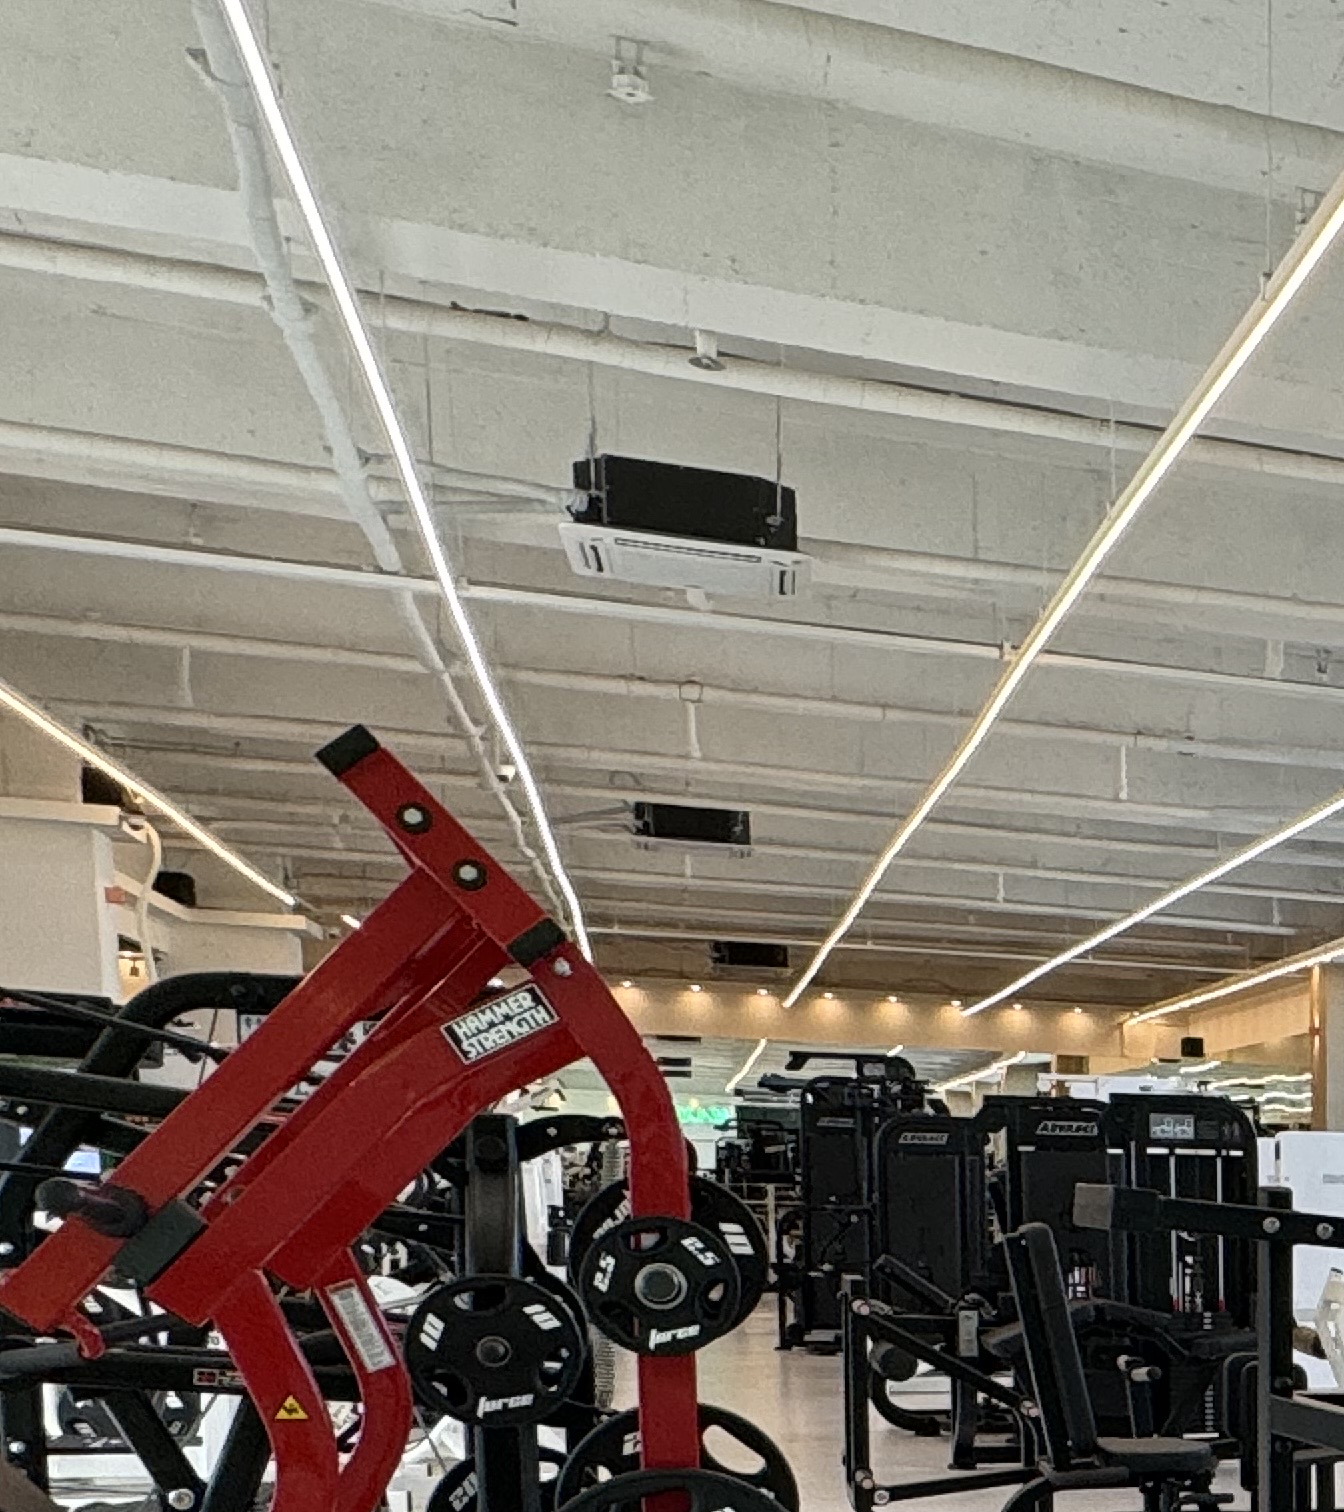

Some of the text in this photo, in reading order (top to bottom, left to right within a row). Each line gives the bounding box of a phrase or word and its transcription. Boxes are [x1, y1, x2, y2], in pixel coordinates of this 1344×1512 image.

[452, 992, 537, 1041] HAMMER
[460, 1004, 552, 1060] STRENGTH
[419, 1312, 446, 1352] 10
[522, 1304, 563, 1331] 10
[648, 1324, 701, 1351] force
[476, 1394, 534, 1419] force
